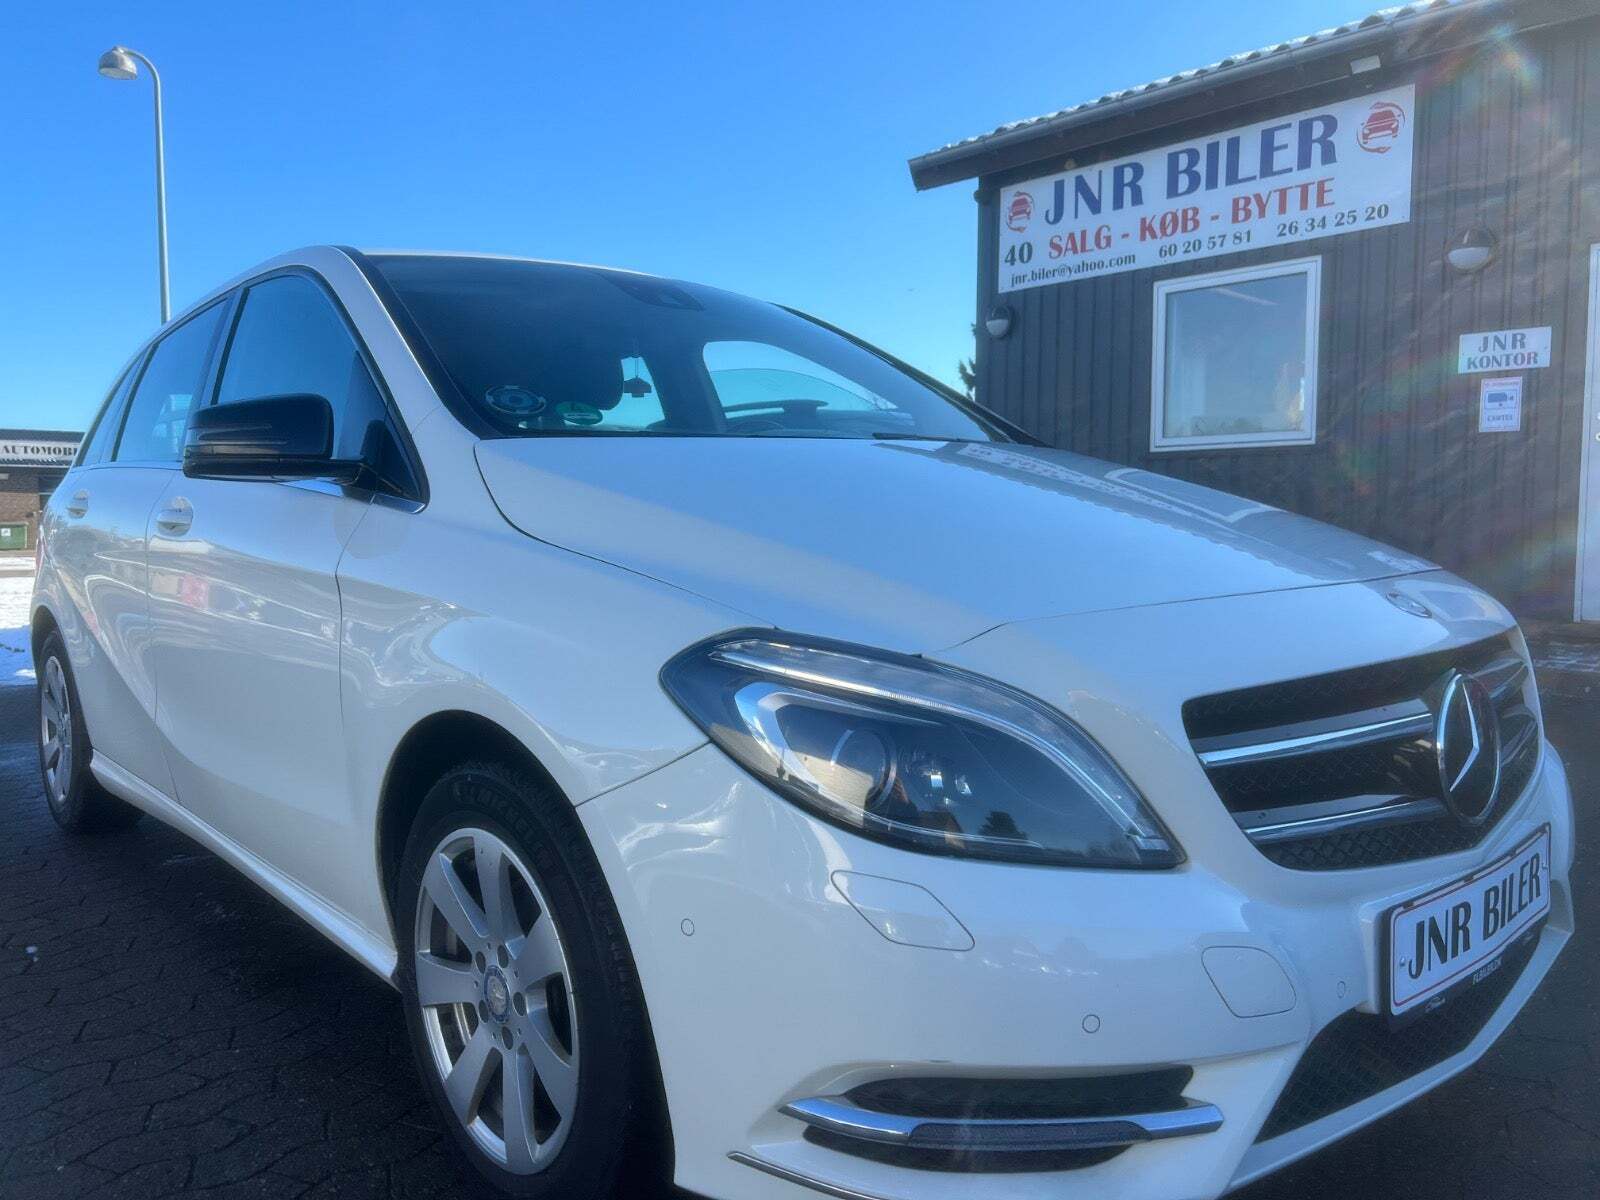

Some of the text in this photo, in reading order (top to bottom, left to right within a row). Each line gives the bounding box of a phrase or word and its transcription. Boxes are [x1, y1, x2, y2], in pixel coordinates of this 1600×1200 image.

[1045, 114, 1338, 225] JNR BILER
[1049, 224, 1112, 259] SALG
[1139, 206, 1200, 242] KØB
[1231, 177, 1335, 225] BYTTE
[1277, 204, 1389, 238] 26 34 25 20
[1004, 241, 1033, 266] 40
[1159, 230, 1251, 259] 60 20 57 81
[1010, 253, 1136, 287] jnr.biler@yahoo.com
[1478, 332, 1526, 353] JNR
[1467, 352, 1538, 370] KONTOR
[1408, 852, 1540, 979] JNR BILER
